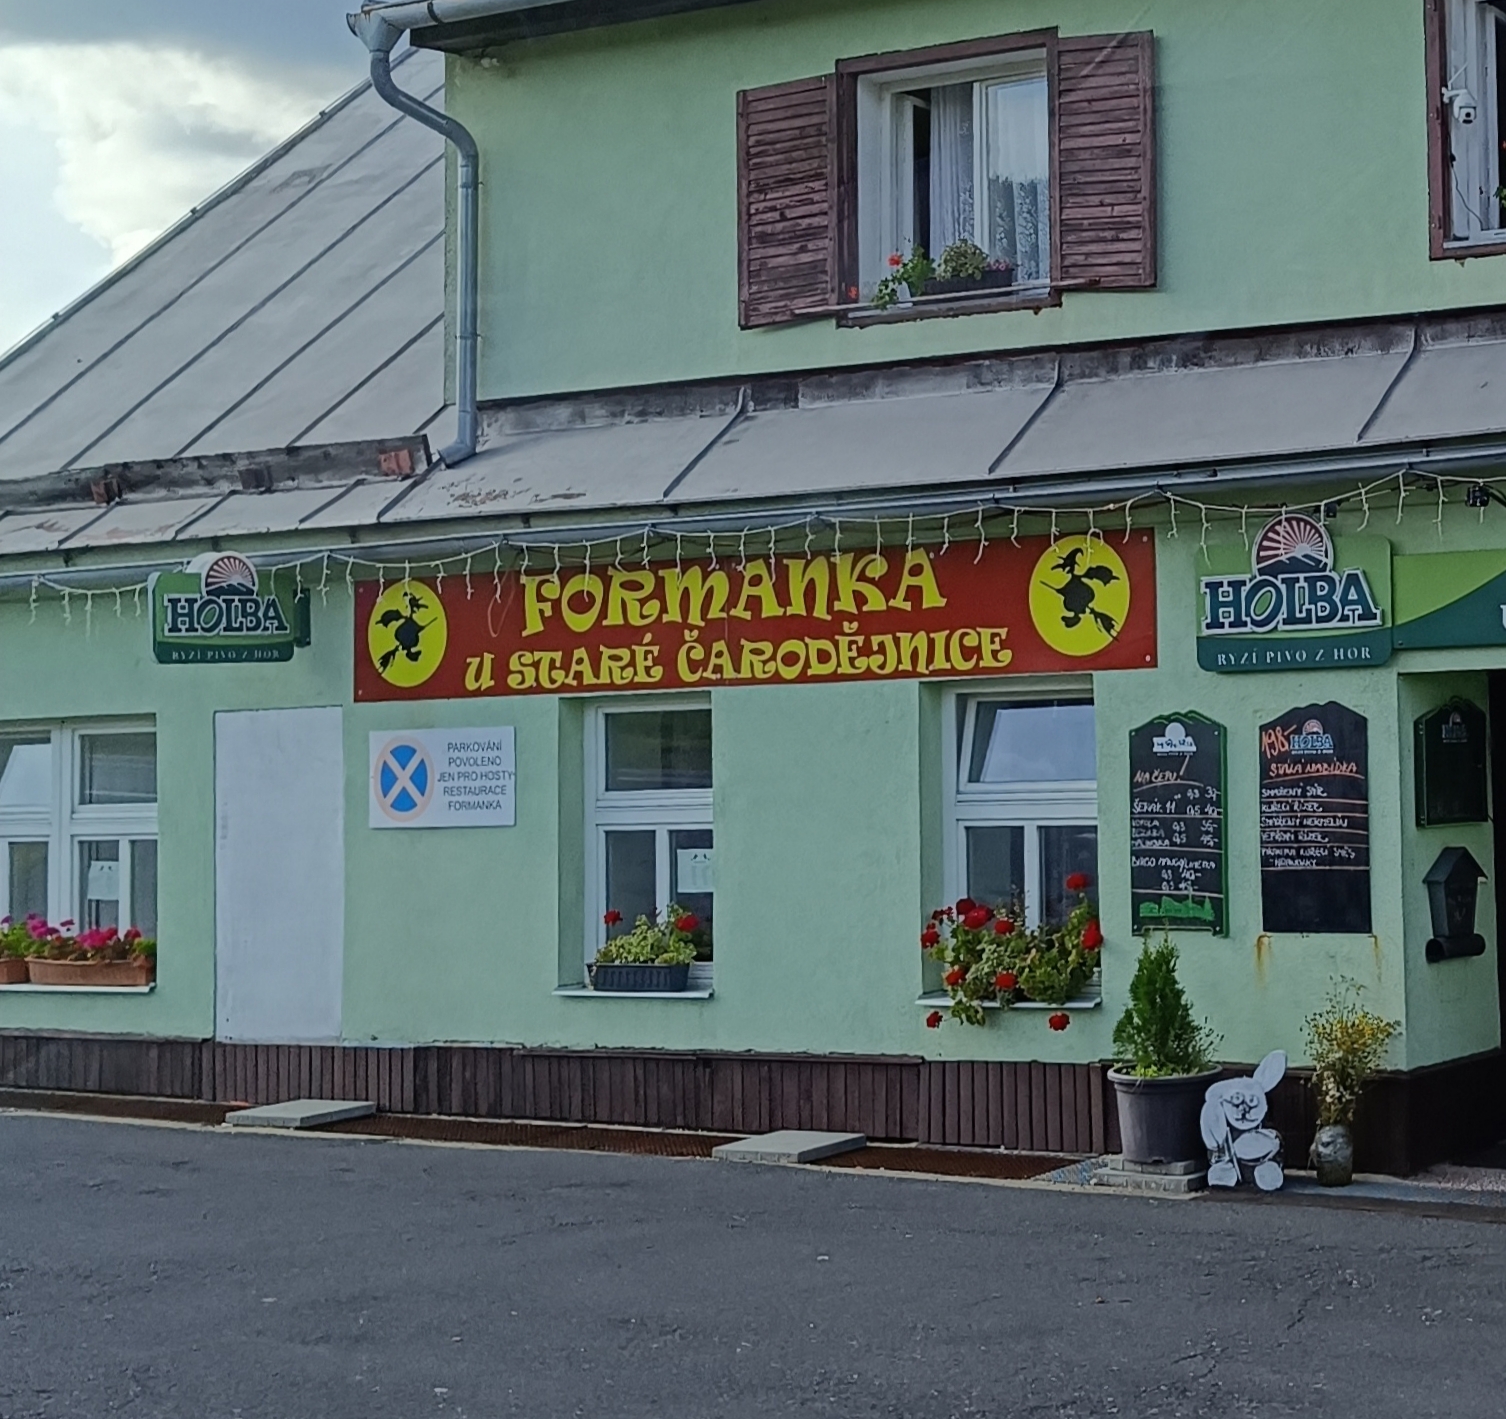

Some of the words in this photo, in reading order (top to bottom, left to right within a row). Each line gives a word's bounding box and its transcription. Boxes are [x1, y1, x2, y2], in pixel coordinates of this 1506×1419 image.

[520, 547, 948, 637] FORMANKA
[1201, 567, 1383, 636] HOLBA
[165, 594, 290, 636] HOLBA
[507, 632, 664, 689] STARÉ
[677, 621, 1013, 683] ČARODĚJNICE
[1217, 648, 1257, 666] RYZÍ
[1266, 649, 1307, 664] PIVO
[1315, 648, 1325, 661] Z
[1333, 646, 1371, 660] HOR
[447, 739, 502, 753] PARKOVÁNÍ
[1290, 734, 1334, 750] HOLBA
[448, 755, 502, 768] POVOLENO
[437, 771, 456, 783] JEN
[457, 771, 479, 782] PRO
[480, 770, 513, 781] HOSTY
[443, 784, 507, 797] RESTAURACE
[448, 799, 502, 811] FORMANKA
